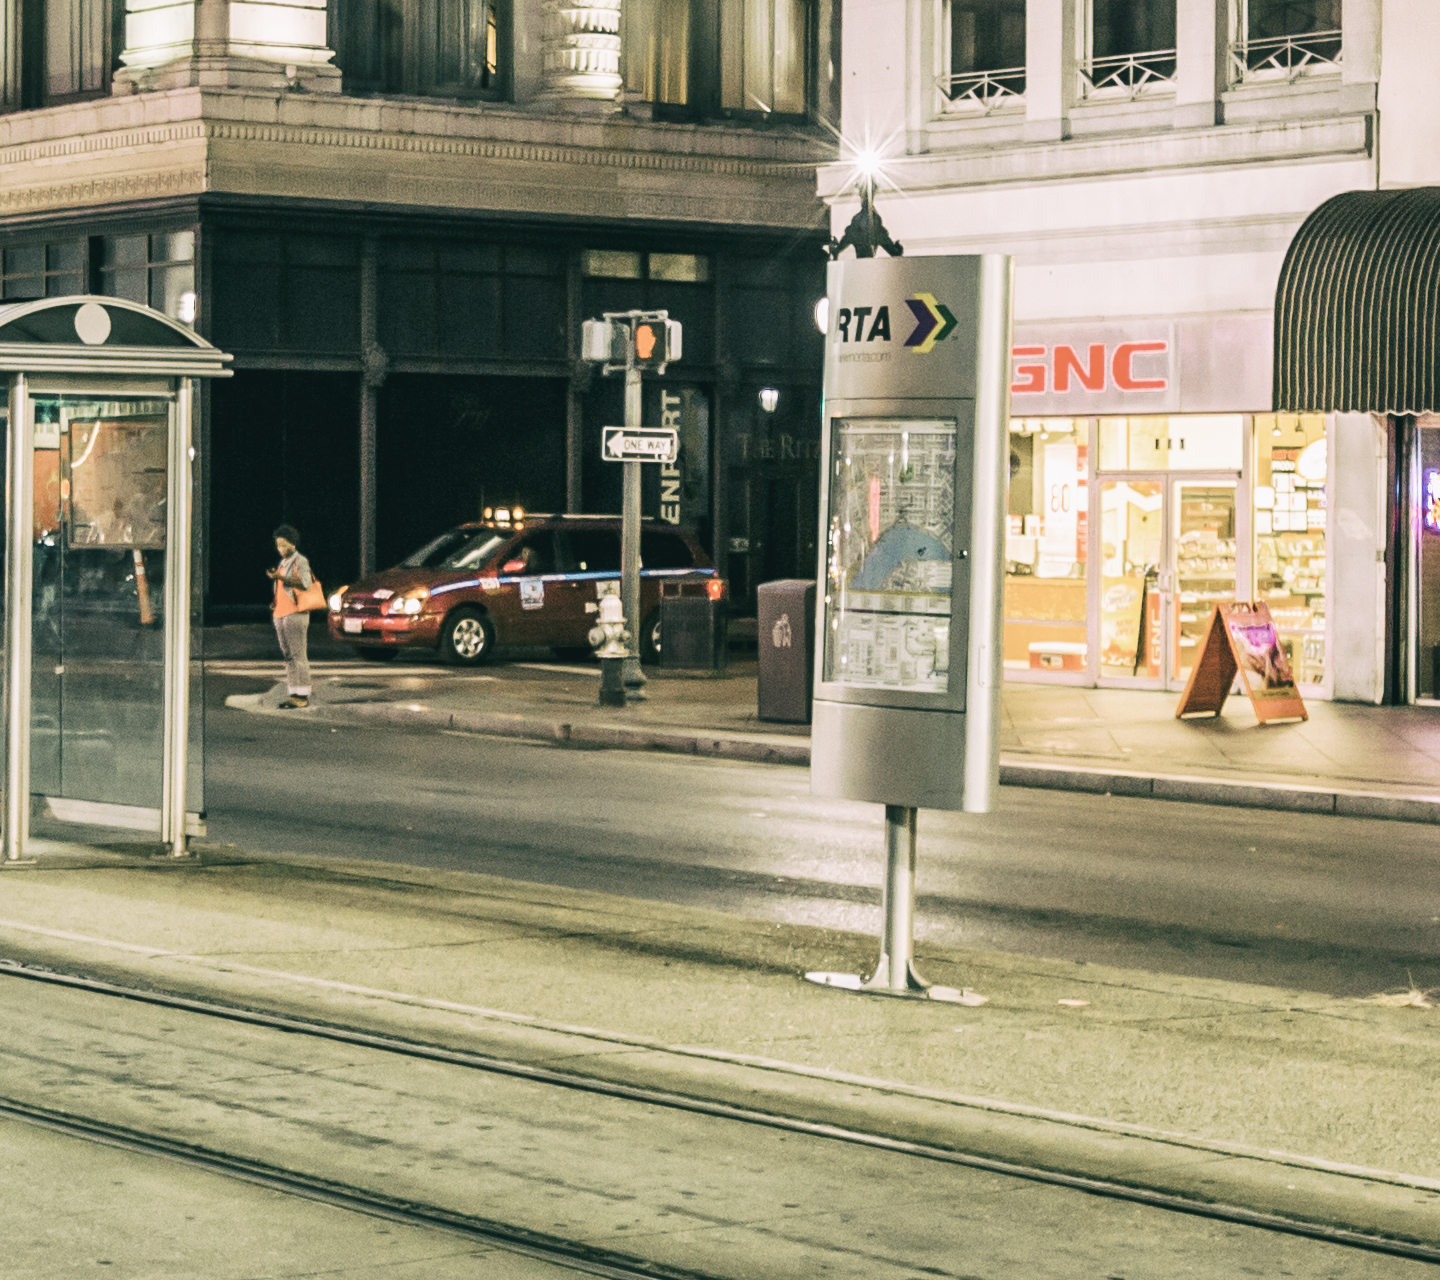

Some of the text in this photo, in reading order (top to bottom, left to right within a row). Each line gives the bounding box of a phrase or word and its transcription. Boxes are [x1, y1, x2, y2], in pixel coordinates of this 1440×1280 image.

[838, 306, 891, 342] RTA
[1011, 340, 1169, 394] GNC
[624, 439, 667, 451] ONE WAY
